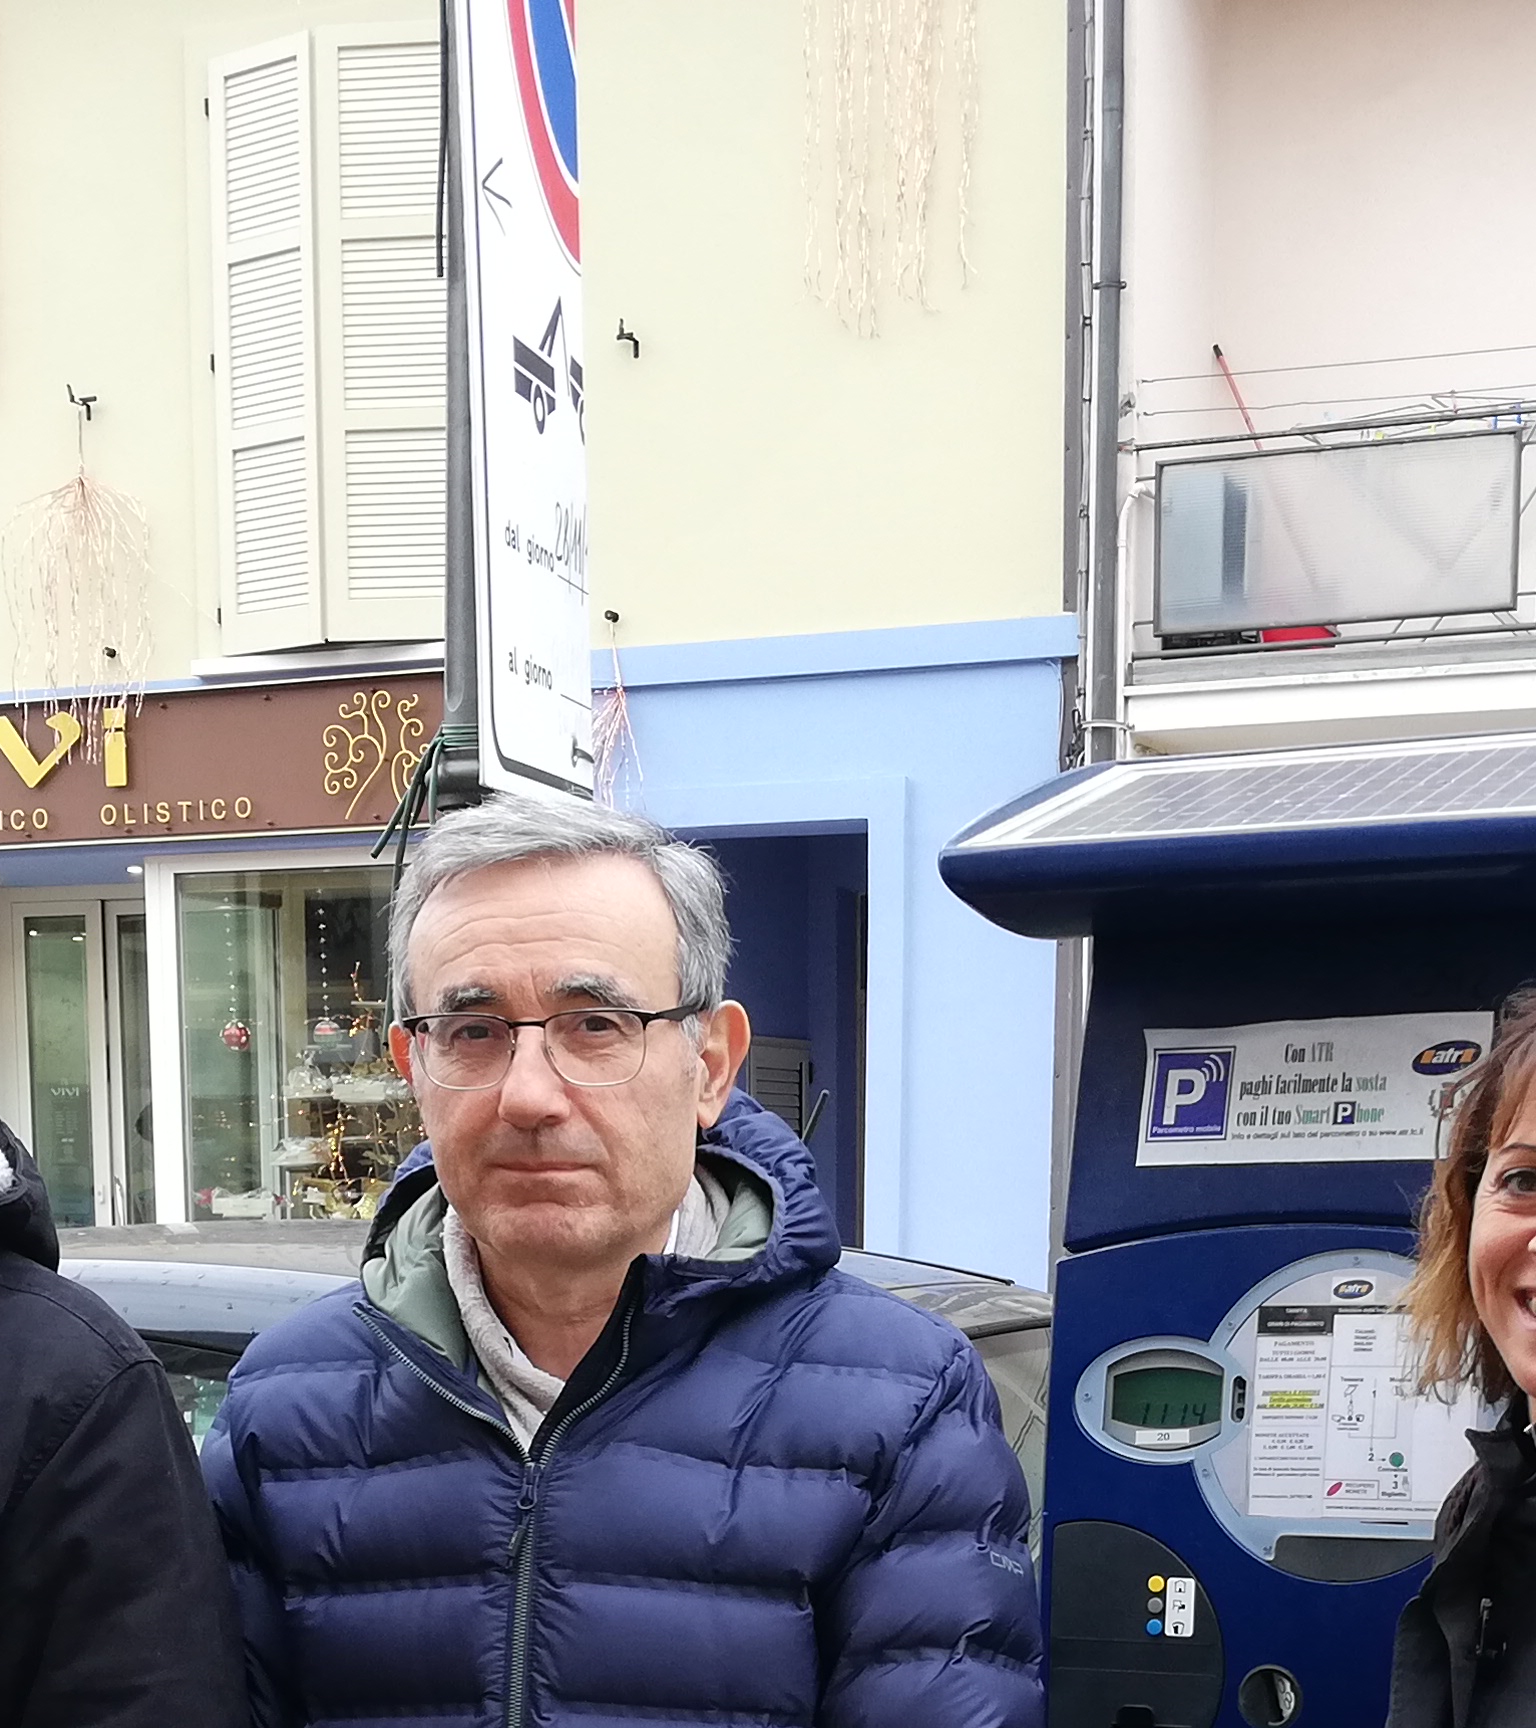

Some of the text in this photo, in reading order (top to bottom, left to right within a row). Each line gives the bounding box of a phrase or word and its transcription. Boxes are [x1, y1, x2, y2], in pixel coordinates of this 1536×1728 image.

[505, 519, 554, 572] dal giorno
[555, 501, 588, 606] 28/11/
[509, 646, 519, 675] al
[525, 654, 552, 690] giorno
[100, 796, 252, 827] OLISTICO
[1284, 1043, 1306, 1064] Con
[1239, 1072, 1387, 1100] paghi facilmente la sosta
[1236, 1110, 1257, 1127] con
[1260, 1105, 1269, 1126] il
[1272, 1107, 1292, 1126] tuo
[1157, 1432, 1170, 1442] 20
[1368, 1453, 1375, 1462] 2
[1392, 1480, 1399, 1490] 3
